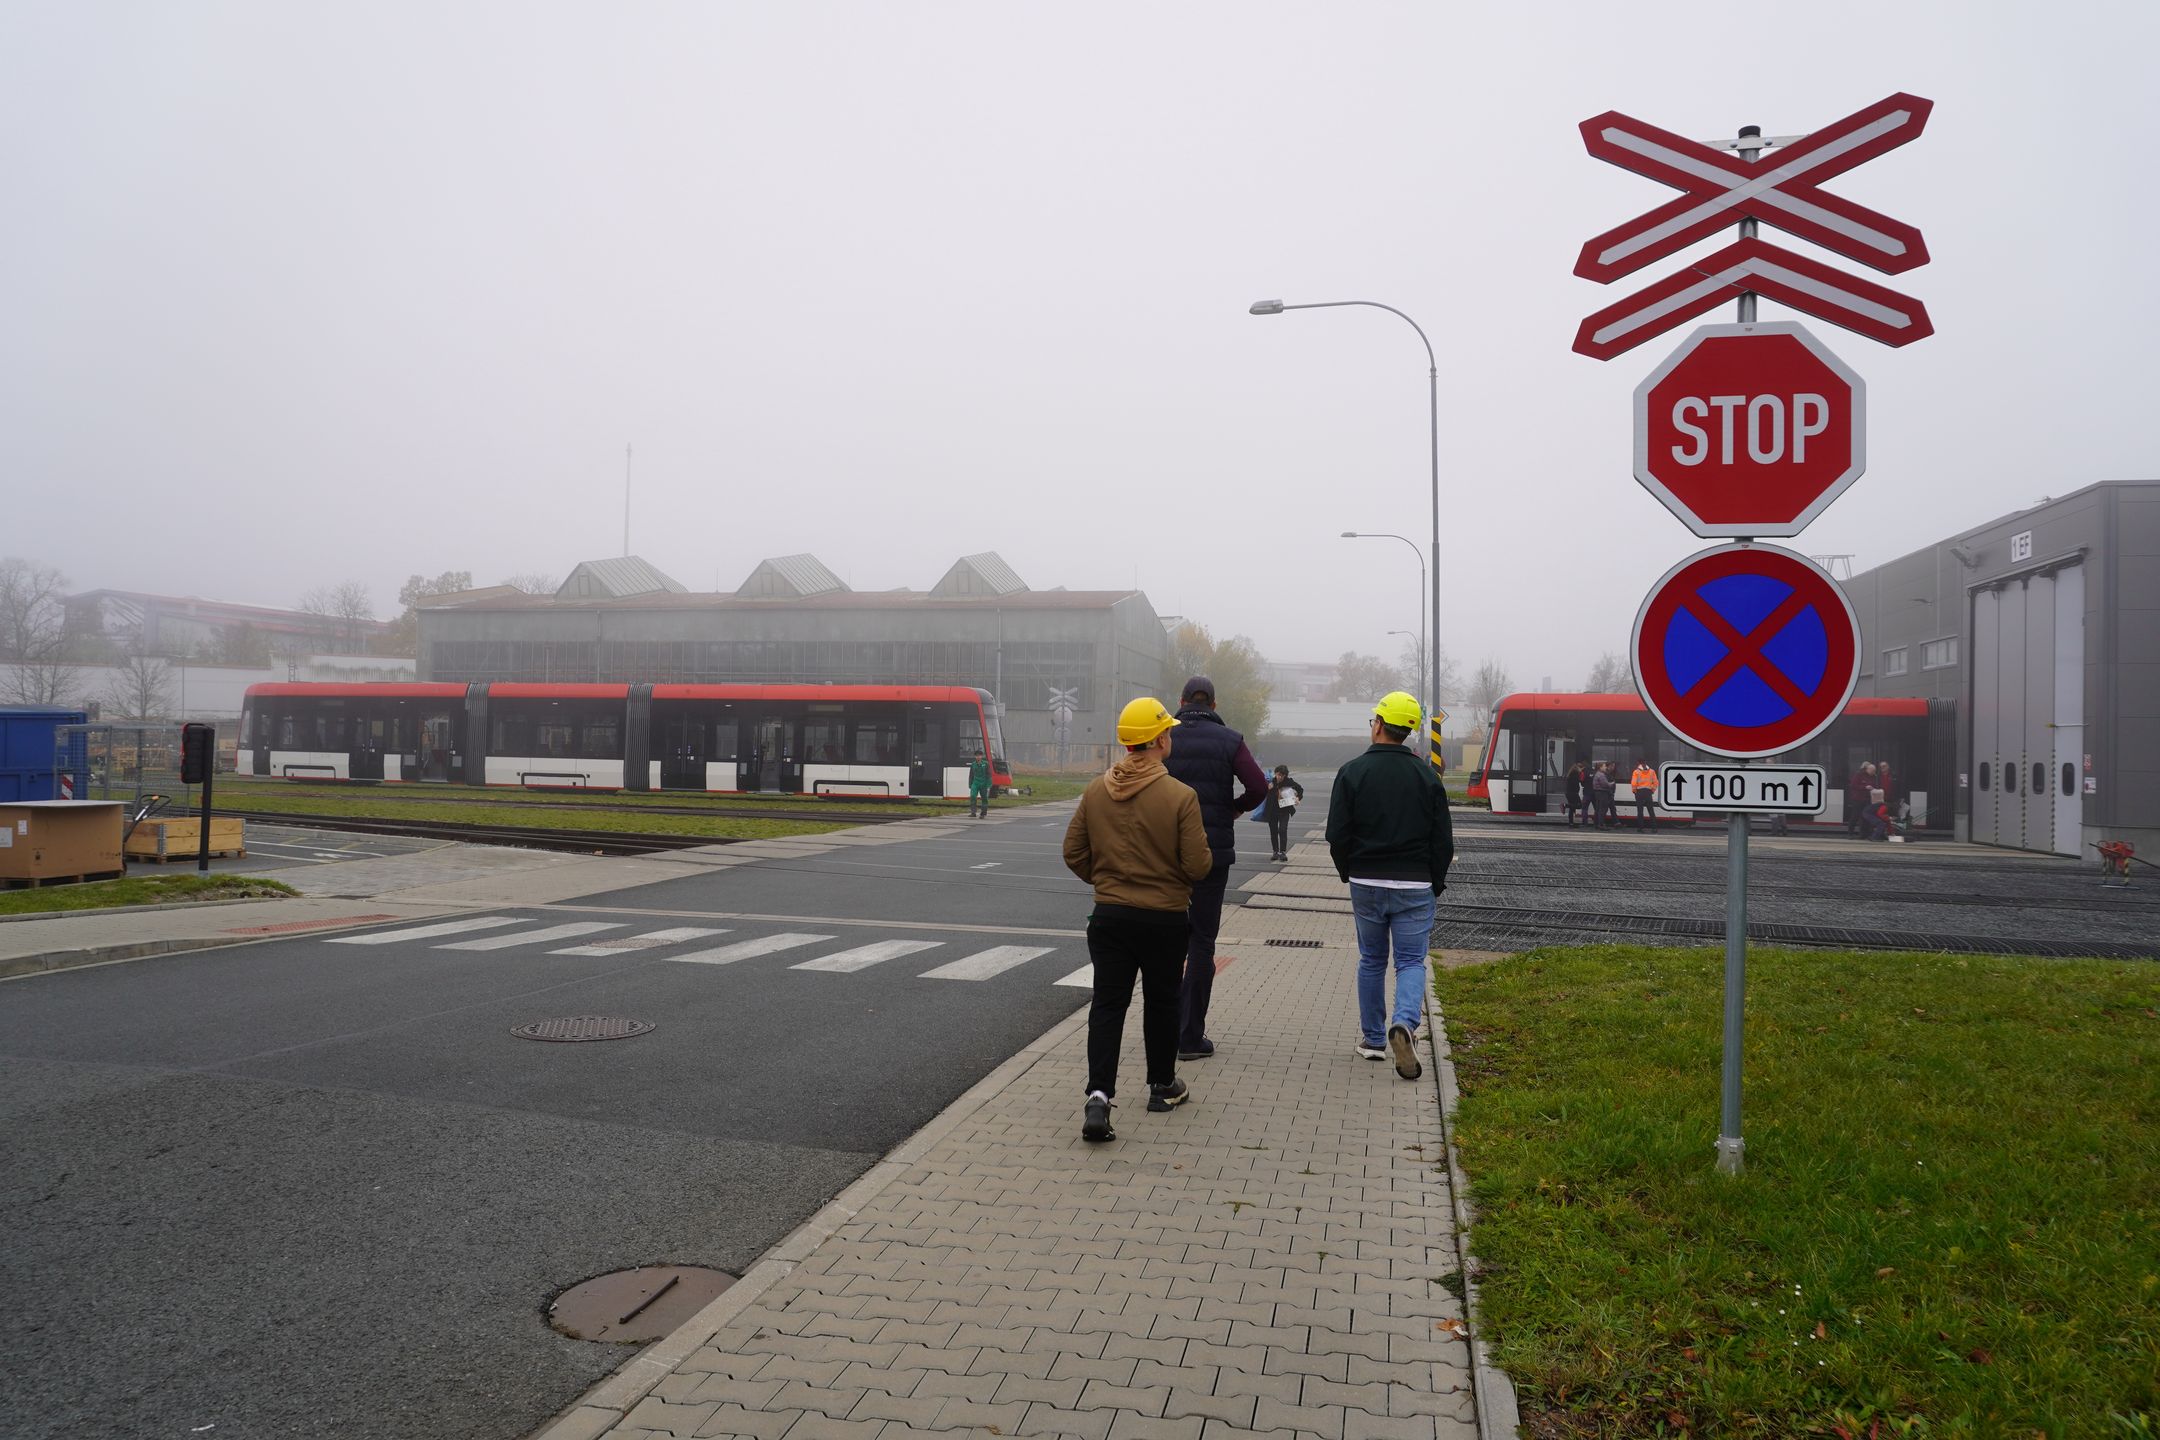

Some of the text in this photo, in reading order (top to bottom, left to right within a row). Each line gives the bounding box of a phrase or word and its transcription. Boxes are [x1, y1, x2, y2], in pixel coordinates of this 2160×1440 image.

[1671, 393, 1830, 466] STOP
[1696, 774, 1788, 801] 100 m
